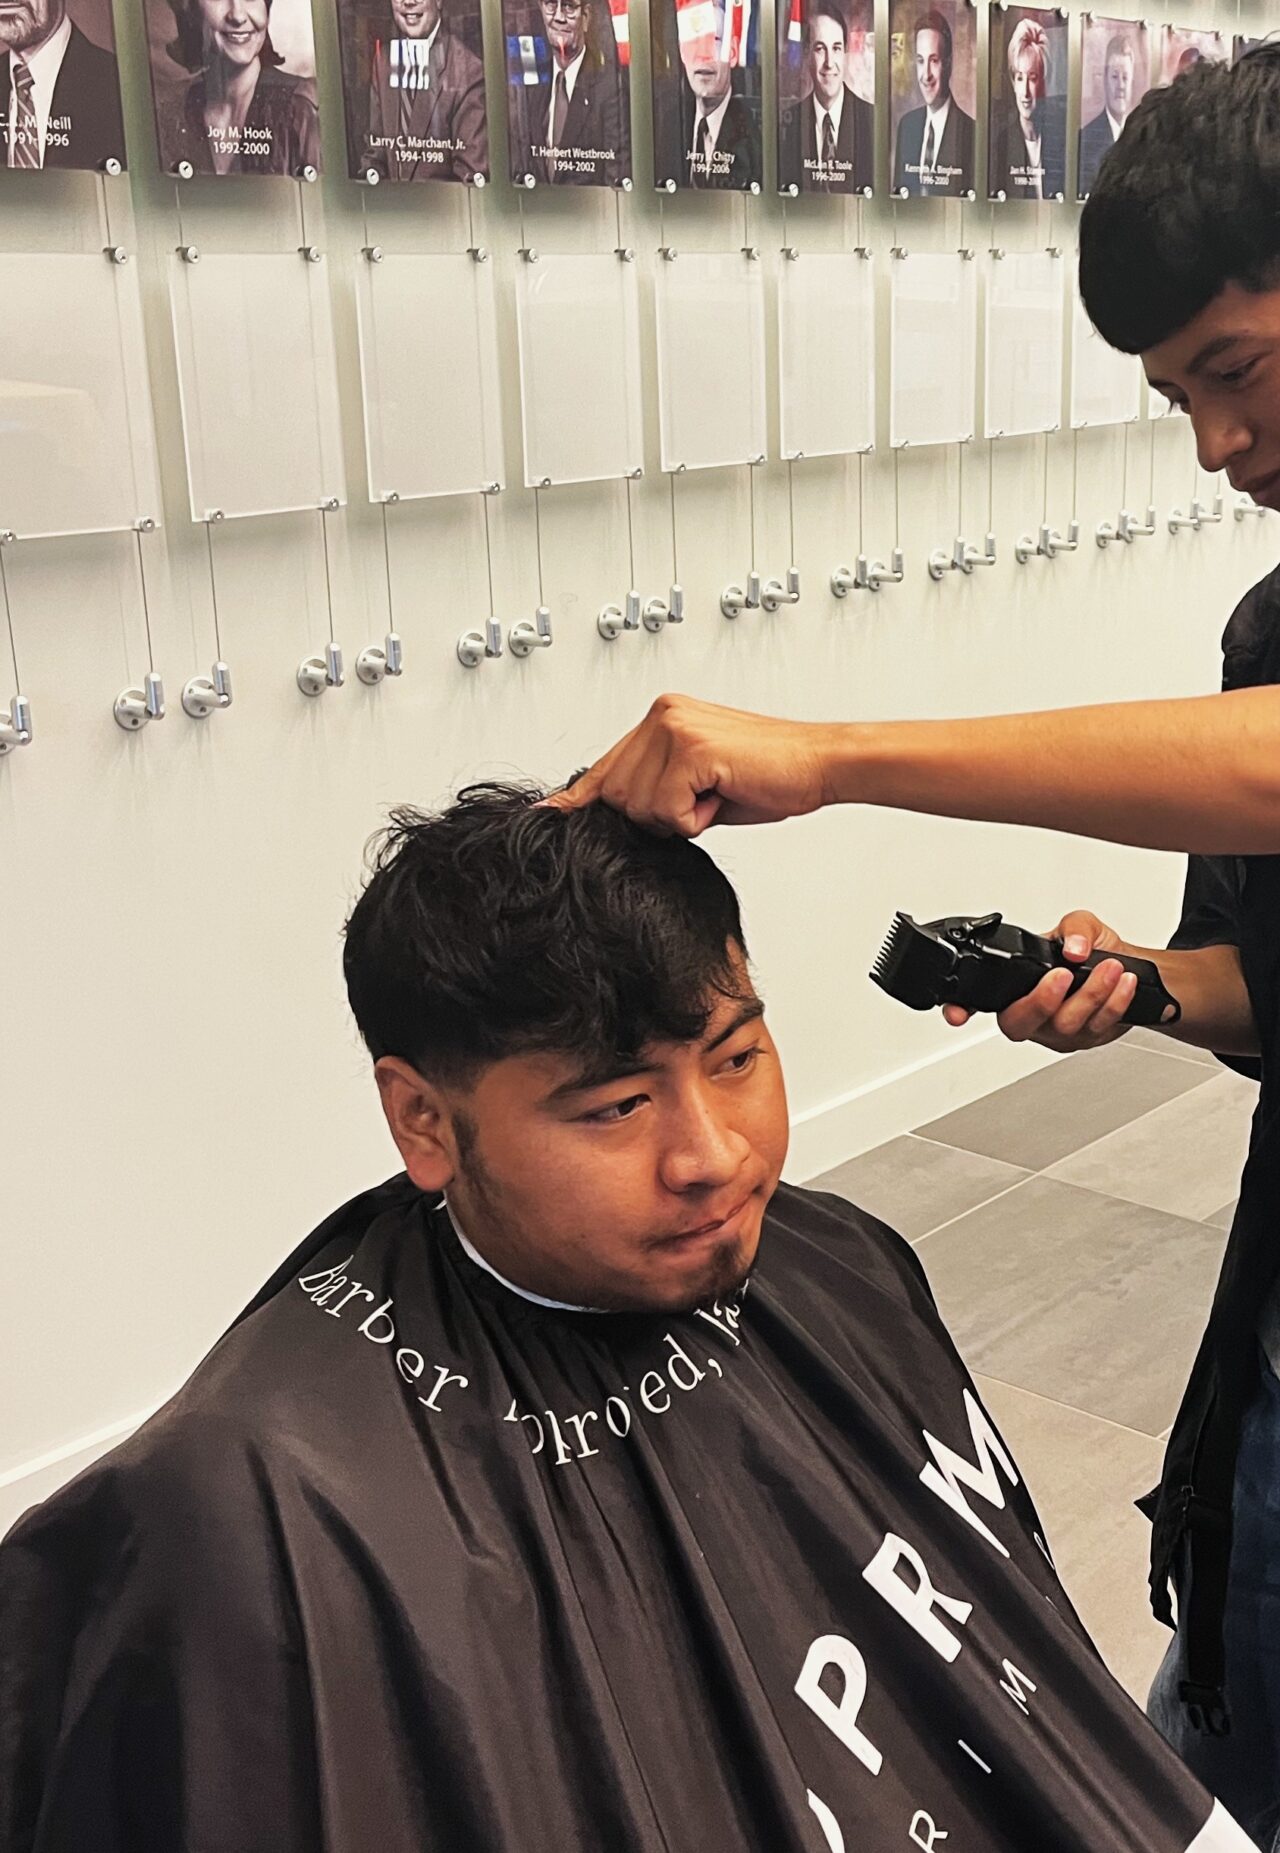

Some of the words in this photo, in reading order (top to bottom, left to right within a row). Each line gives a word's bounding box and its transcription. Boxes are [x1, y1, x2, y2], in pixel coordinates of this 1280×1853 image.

[24, 115, 72, 130] MNeill
[3, 130, 70, 147] 1991-996
[207, 125, 226, 140] Joy
[228, 125, 242, 139] M.
[243, 126, 273, 140] Hook
[213, 141, 270, 155] 1992-2000
[369, 134, 395, 150] Larry
[407, 136, 454, 150] Marchant,
[455, 138, 466, 150] Jr.
[395, 150, 444, 163] 1994-1998
[530, 145, 538, 157] T.
[539, 146, 571, 158] Herbert
[572, 147, 616, 160] Westbrook
[685, 149, 704, 163] Jerry
[554, 160, 596, 173] 1994-2002
[298, 1254, 470, 1414] barber
